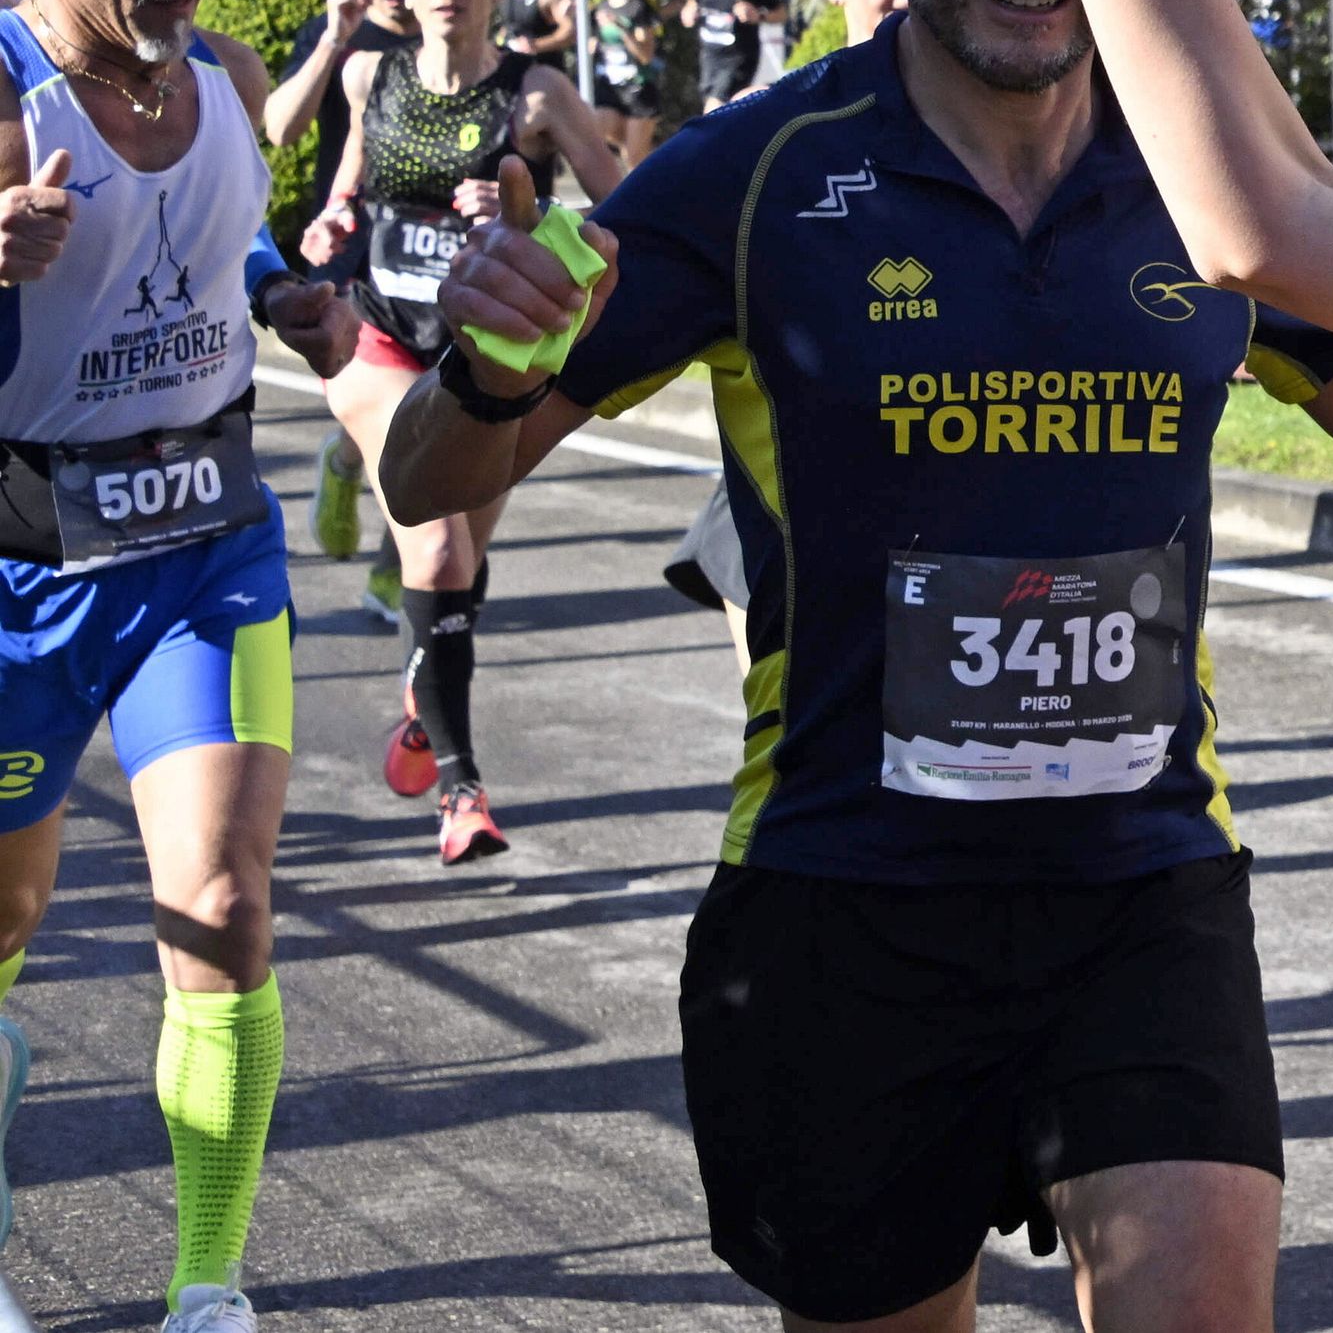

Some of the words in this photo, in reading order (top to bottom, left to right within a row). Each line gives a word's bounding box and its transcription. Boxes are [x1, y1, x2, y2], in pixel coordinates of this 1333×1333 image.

[402, 223, 468, 260] 108
[869, 298, 938, 322] errea
[79, 321, 229, 381] INTERFORZE
[111, 326, 158, 348] GRUPPO
[139, 373, 183, 393] TORINO
[880, 371, 1183, 405] POLISPORTIVA
[880, 404, 1182, 455] TORRILE
[95, 457, 223, 520] 5070
[904, 575, 926, 605] E
[950, 612, 1136, 687] 3418
[1020, 695, 1072, 711] PIERO
[993, 722, 1040, 730] MARANELLO
